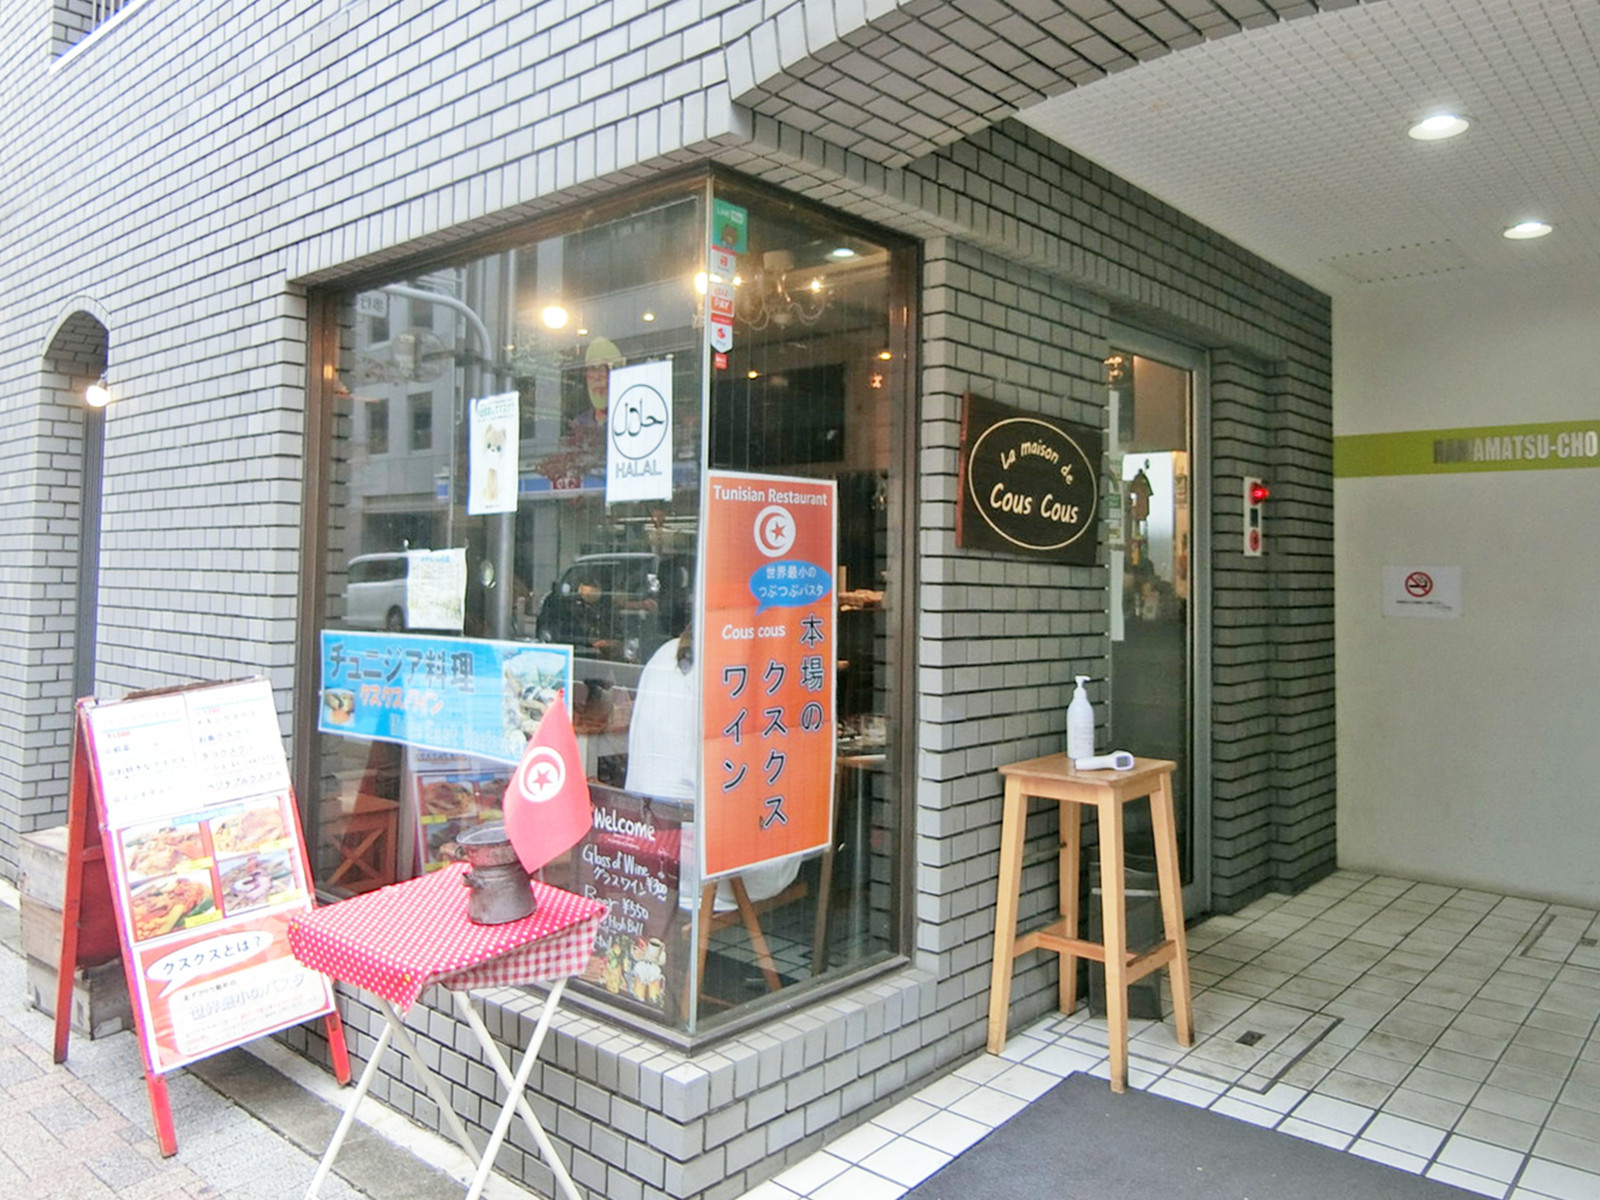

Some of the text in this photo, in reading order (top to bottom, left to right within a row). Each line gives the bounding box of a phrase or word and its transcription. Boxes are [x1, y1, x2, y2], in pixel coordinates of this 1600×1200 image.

[614, 398, 664, 437] حلال
[1000, 439, 1074, 485] La maison de
[1434, 431, 1598, 464] AMATSU-CHO
[615, 459, 663, 479] HALAL
[713, 484, 828, 506] Tunisian Restaurant
[990, 482, 1079, 524] Cous Cous
[766, 565, 817, 579] 世界最小の
[758, 583, 824, 599] つぶつぶパスタ
[721, 624, 786, 640] Cous cous
[328, 643, 475, 694] チュニジア料理
[800, 613, 824, 732] 本場の
[723, 665, 749, 793] ワイン
[762, 659, 788, 829] クスクス
[594, 807, 656, 841] Welcome
[583, 844, 611, 869] Glass
